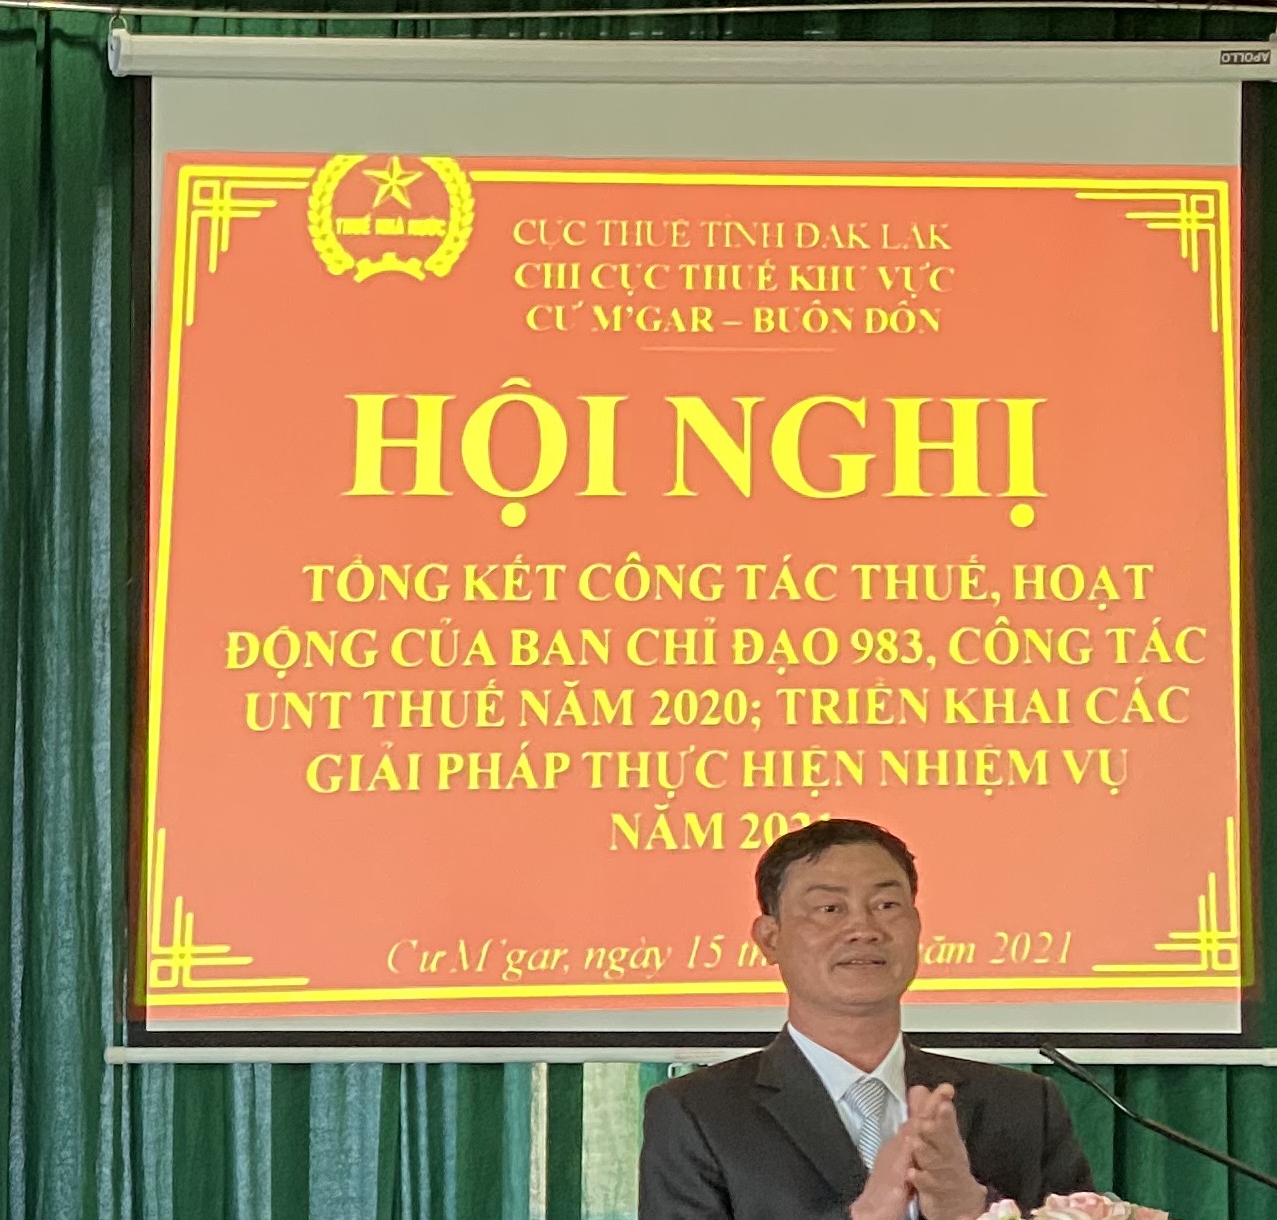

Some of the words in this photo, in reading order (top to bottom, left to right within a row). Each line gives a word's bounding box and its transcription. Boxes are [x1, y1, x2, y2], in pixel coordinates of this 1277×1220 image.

[1221, 51, 1271, 63] APOLLO
[514, 262, 582, 290] CHI
[590, 262, 670, 297] CỤC
[789, 263, 868, 292] KHU
[877, 262, 955, 299] VỰC
[341, 376, 629, 528] HỘI
[663, 393, 1048, 529] NGHỊ
[302, 553, 451, 604] TỔNG
[463, 554, 567, 603] KẾT
[577, 550, 726, 602] CÔNG
[736, 554, 838, 602] TÁC
[851, 555, 1002, 607] THUẾ,
[1012, 563, 1155, 611] HOẠT
[225, 625, 379, 680] ĐỘNG
[389, 617, 497, 669] CỦA
[510, 627, 612, 668] BAN
[626, 617, 717, 667] CHỈ
[731, 627, 841, 676] ĐẠO
[849, 627, 938, 670] 983,
[947, 615, 1094, 666] CÔNG
[1105, 617, 1208, 666] TÁC
[245, 690, 353, 732] UNT
[363, 678, 506, 730] THUẾ
[519, 679, 635, 728] NĂM
[650, 688, 762, 730] 2020;
[775, 678, 930, 726] TRIỂN
[944, 687, 1071, 726] KHAI
[1084, 677, 1191, 725] CÁC
[305, 740, 422, 794] GIẢI
[436, 741, 572, 792] PHÁP
[582, 745, 728, 799] THỰC
[742, 744, 865, 798] HIỆN
[880, 744, 1049, 797] NHIỆM
[1062, 746, 1128, 796] VỤ
[611, 802, 726, 851] NĂM
[387, 938, 446, 974] Cư
[583, 936, 673, 980] ngày
[687, 934, 725, 969] 15
[919, 935, 976, 965] ăm
[989, 931, 1072, 965] 2021
